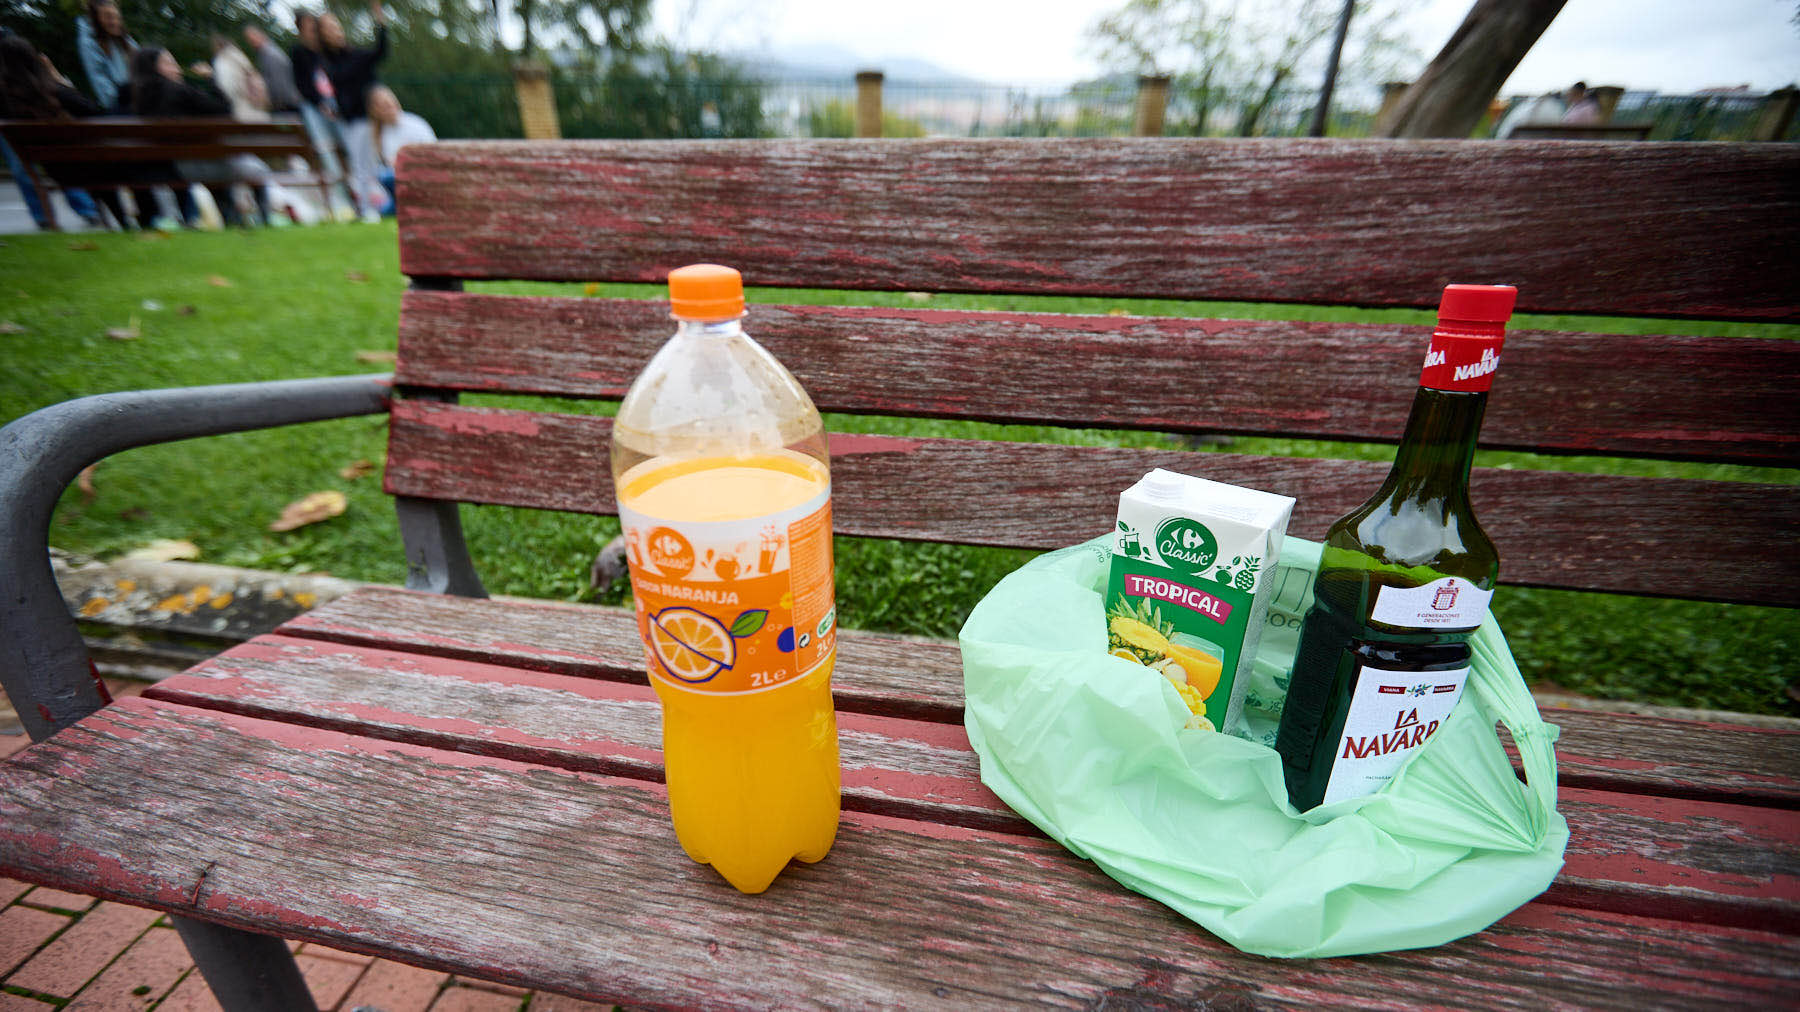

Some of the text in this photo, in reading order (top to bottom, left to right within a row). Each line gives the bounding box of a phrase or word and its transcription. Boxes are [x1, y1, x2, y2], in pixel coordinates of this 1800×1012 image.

[1480, 347, 1495, 362] LA
[1160, 540, 1213, 566] Classic
[661, 583, 739, 606] NARANJA
[1131, 576, 1221, 618] TROPICAL
[1393, 707, 1420, 731] LA
[1341, 714, 1451, 759] NAVARR
